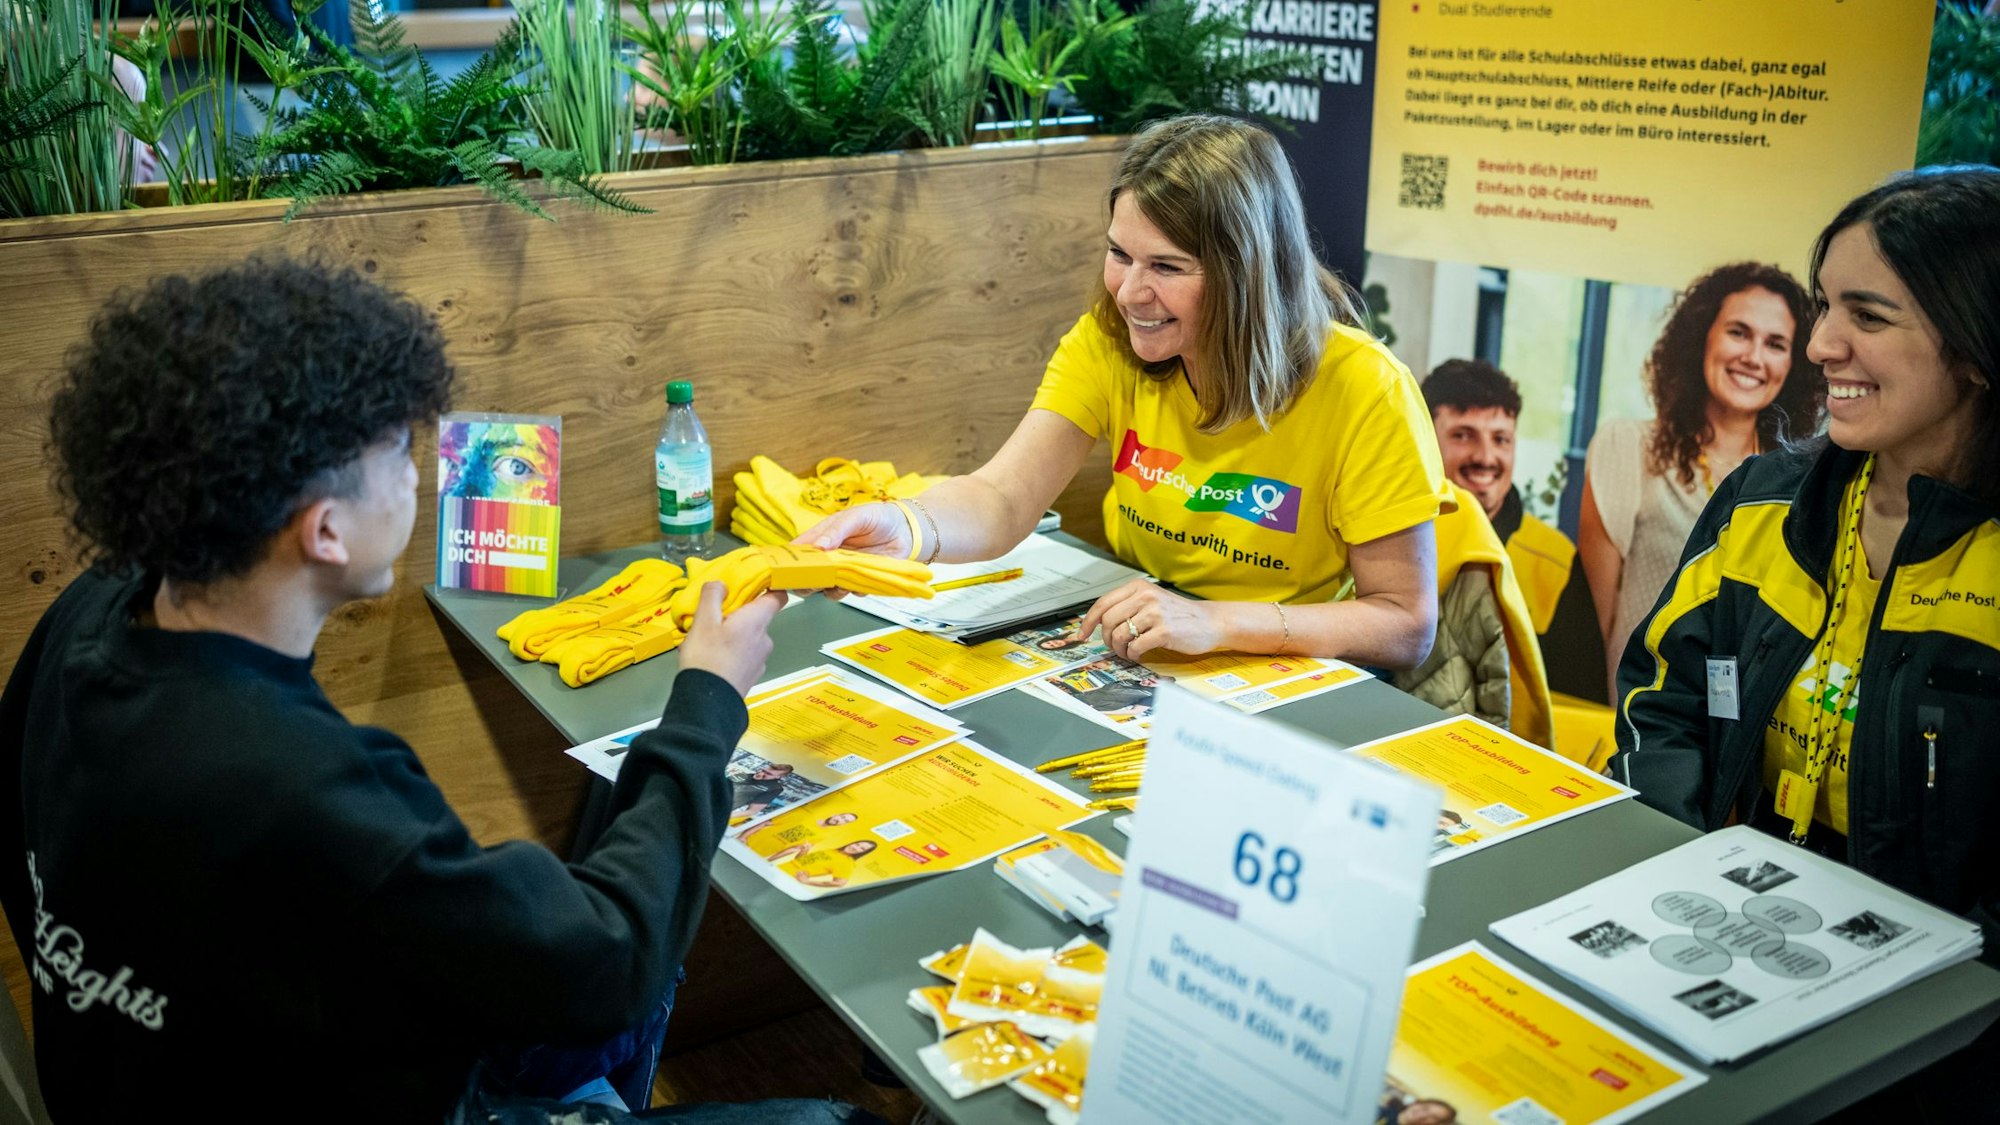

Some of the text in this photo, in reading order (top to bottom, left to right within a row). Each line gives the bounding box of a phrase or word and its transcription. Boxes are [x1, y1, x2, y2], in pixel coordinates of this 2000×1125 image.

[1439, 3, 1552, 18] Dual Studierende
[1408, 46, 1826, 78] Bei uns ist für alle Schulabschlüsse etwas dabei, ganz egal
[1407, 68, 1829, 102] ob Hauptschulabschluss, Mittlere Reife oder (Fach-)Abitur.
[1406, 88, 1808, 125] Dabei liegt es ganz bei dir, ob dich eine Ausbildung in der
[1404, 111, 1771, 147] Paketzustellung, im Lager oder im Büro interessiert.
[1478, 159, 1598, 182] Bewirb dich jetzt!
[1476, 180, 1654, 210] Einfach QR-Code scannen.
[1474, 202, 1618, 232] dpdhl.de/ausbildung
[1131, 449, 1244, 504] Deutsche Post
[448, 528, 548, 552] ICH MÖCHTE
[1118, 504, 1290, 571] elivered with pride.
[448, 546, 486, 565] DICH
[1965, 592, 1995, 607] Post
[806, 695, 879, 729] TOP-Ausbildung
[1446, 732, 1531, 775] TOP-Ausbildung
[1232, 830, 1303, 904] 68
[1170, 933, 1331, 1035] Deutsche Post AG
[1447, 974, 1562, 1049] TOP-Ausbildung
[1244, 1010, 1287, 1047] Köln
[1292, 1036, 1344, 1079] West
